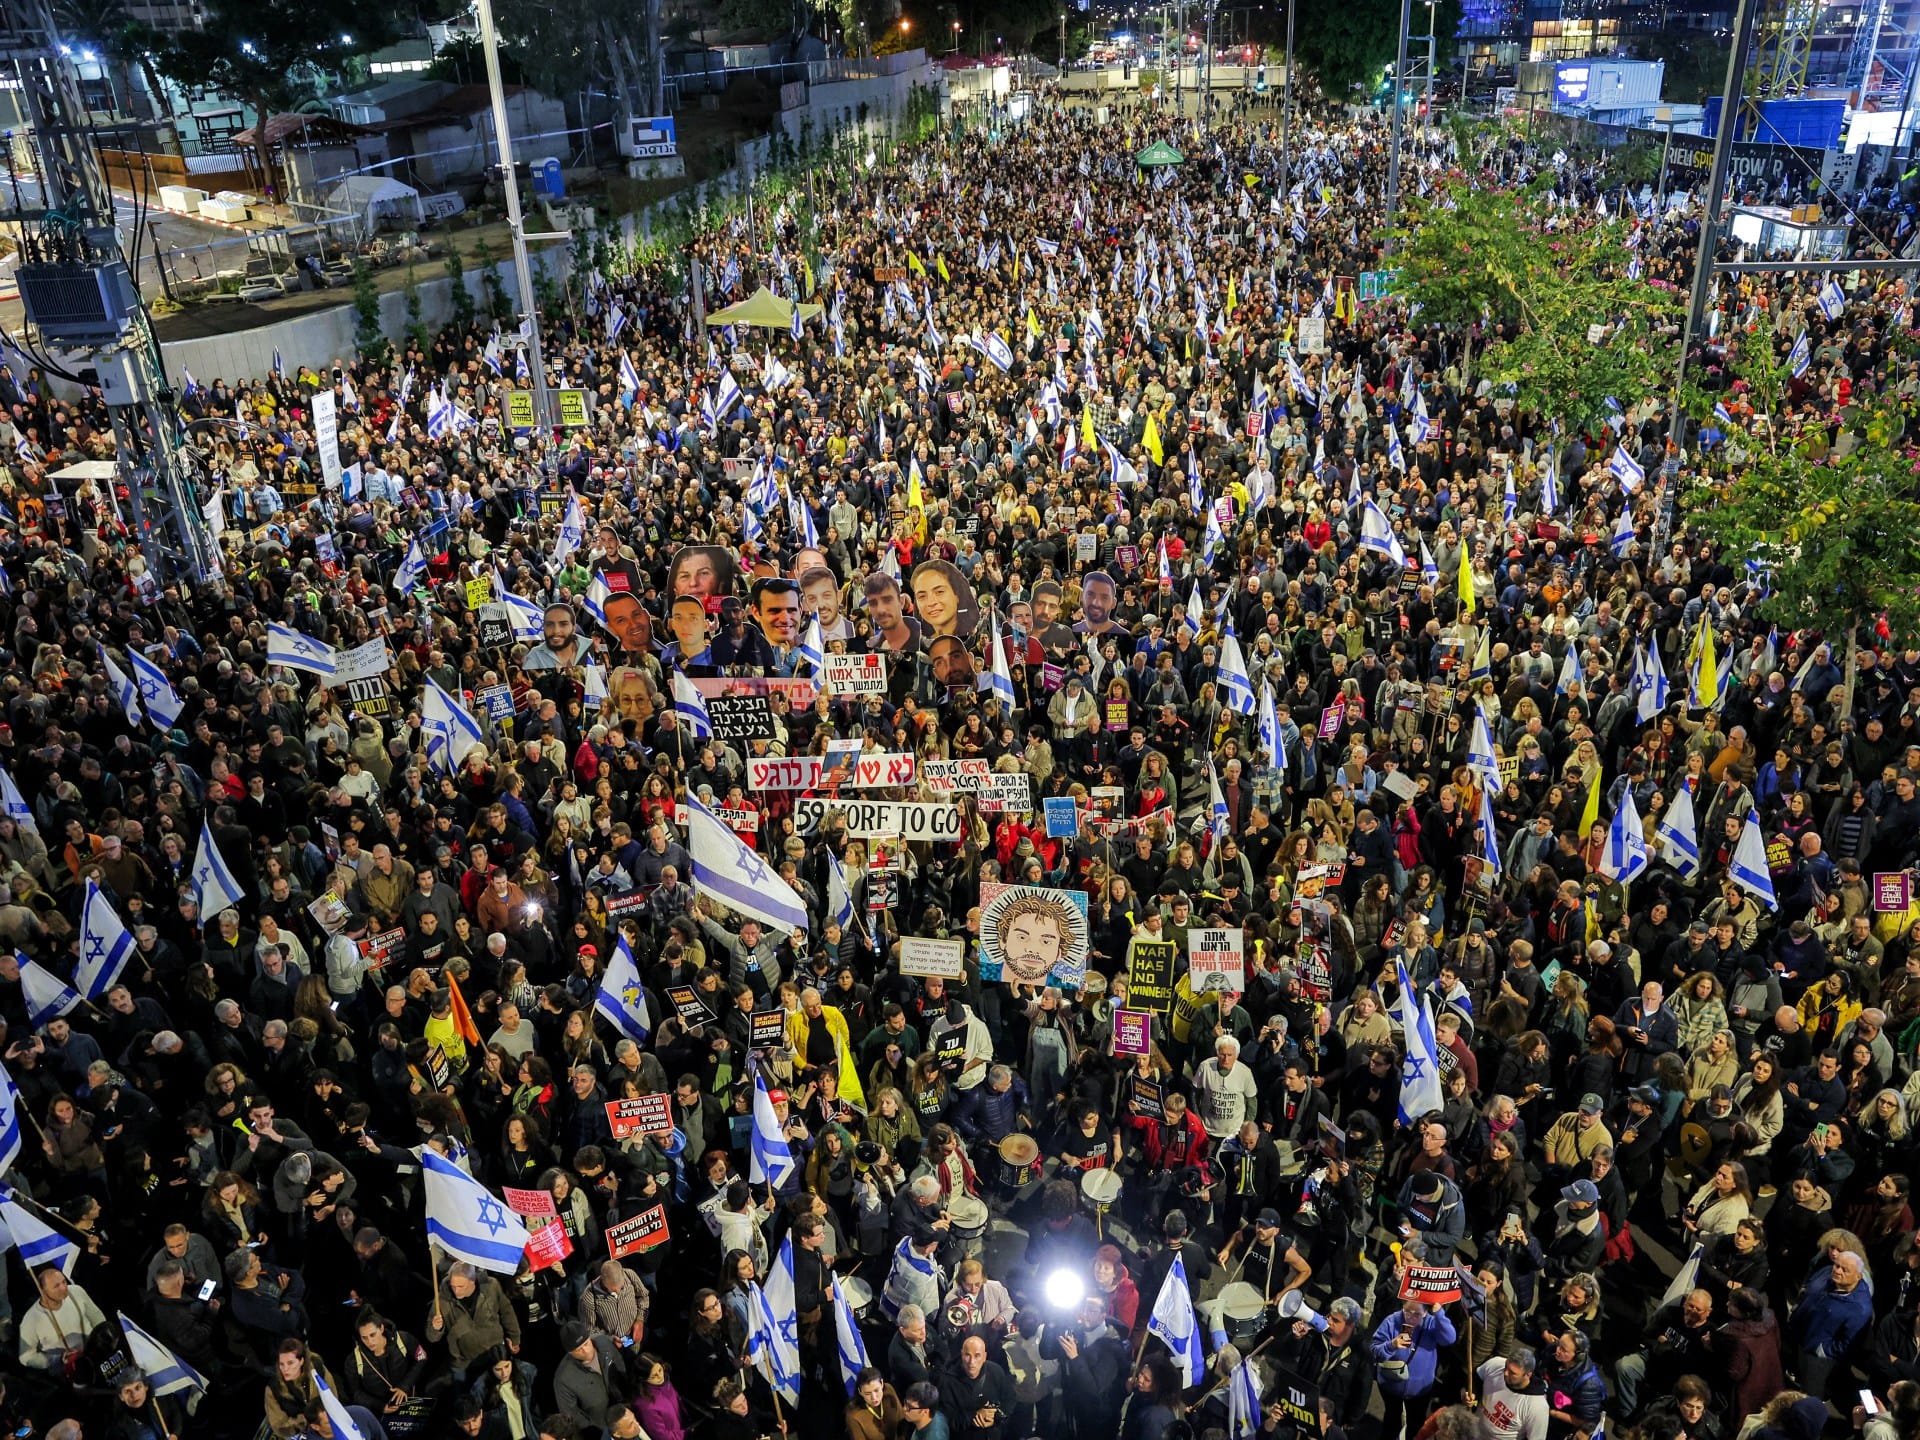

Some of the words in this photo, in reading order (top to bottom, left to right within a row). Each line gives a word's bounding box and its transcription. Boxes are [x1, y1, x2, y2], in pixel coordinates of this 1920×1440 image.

[1669, 147, 1692, 168] RIELI
[1731, 156, 1783, 179] TOWR
[834, 657, 847, 666] לנו
[853, 656, 864, 665] יש
[829, 668, 854, 680] אמון
[856, 667, 882, 679] חוסר
[348, 678, 384, 702] כולם
[832, 682, 845, 693] בך
[849, 680, 882, 692] מתמשך
[710, 701, 730, 713] את
[733, 698, 766, 711] תציל
[713, 712, 769, 724] המדינה
[713, 725, 770, 739] מעצמך
[753, 758, 802, 787] לרגע
[887, 754, 913, 784] לא
[797, 801, 824, 832] 59
[897, 807, 925, 833] TO
[931, 807, 960, 834] GO
[1204, 931, 1226, 941] אתה
[1135, 945, 1166, 958] WAR
[1200, 941, 1230, 952] הראש
[1191, 951, 1216, 961] אשם
[1218, 951, 1241, 961] אתה
[1135, 959, 1164, 971] HAS
[1135, 972, 1155, 984] NO
[1129, 984, 1172, 998] WINNERS
[945, 1037, 960, 1049] עד
[938, 1047, 964, 1060] מתי?
[508, 1194, 548, 1202] DEMANDS
[646, 1210, 660, 1222] אין
[611, 1214, 646, 1237] דמוקרטיה
[650, 1220, 663, 1231] בלי
[615, 1226, 650, 1246] החטופים
[1410, 1268, 1453, 1280] דמוקרטיה
[1410, 1280, 1449, 1291] החטופים
[1287, 1387, 1306, 1407] עד
[1281, 1398, 1315, 1426] מתי?
